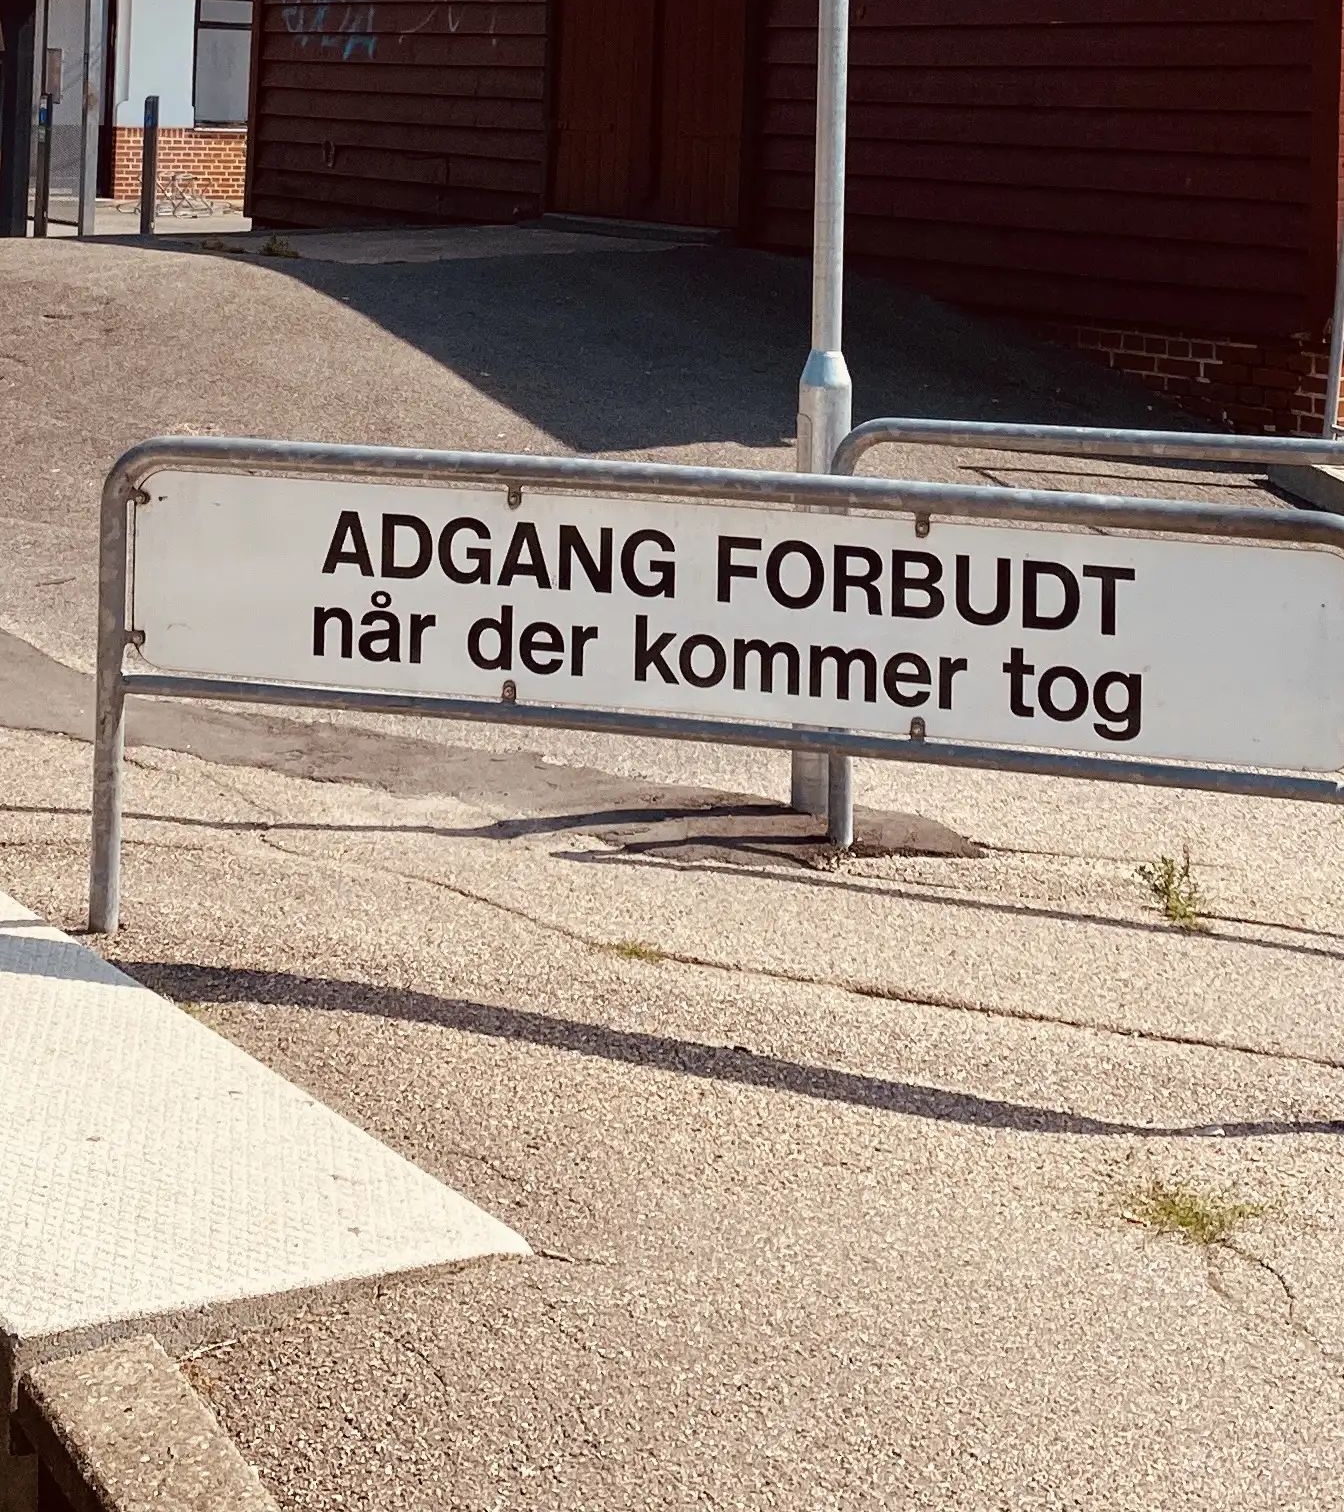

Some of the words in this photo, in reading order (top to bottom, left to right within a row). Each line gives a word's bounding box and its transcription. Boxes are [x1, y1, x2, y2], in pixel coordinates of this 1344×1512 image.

[321, 510, 676, 599] ADGANG
[716, 535, 1136, 636] FORBUDT
[312, 590, 437, 664] når
[467, 604, 599, 677] der
[634, 614, 968, 711] kommer
[1002, 647, 1142, 742] tog
